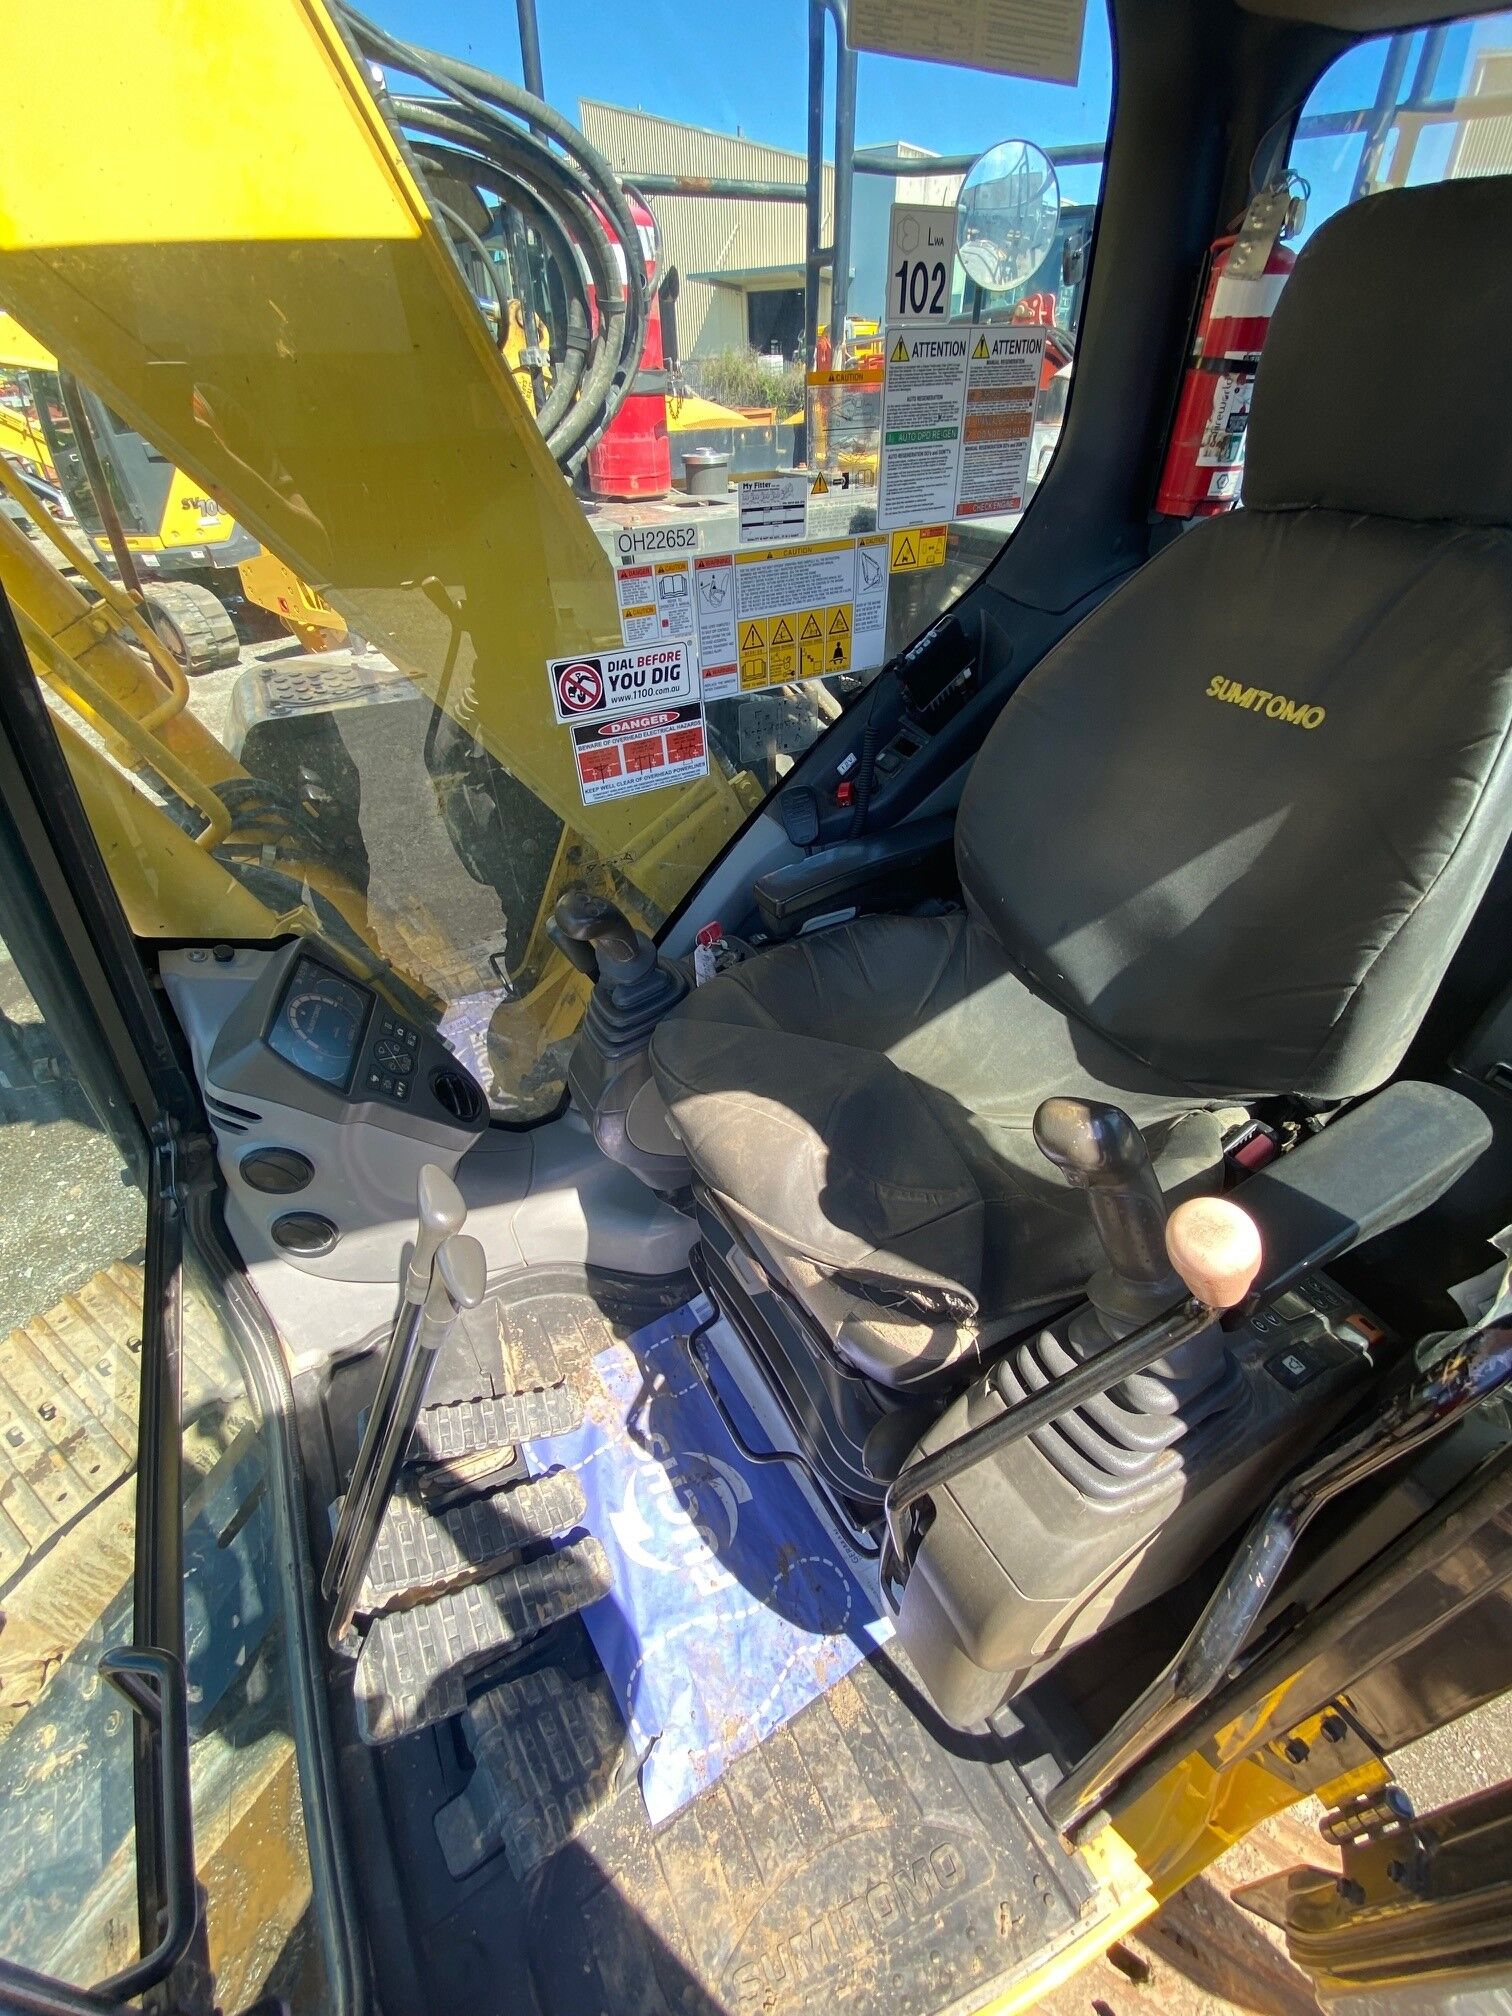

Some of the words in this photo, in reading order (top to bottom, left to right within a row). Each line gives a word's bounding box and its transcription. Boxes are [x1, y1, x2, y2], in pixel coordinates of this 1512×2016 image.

[895, 260, 946, 314] 102
[911, 341, 966, 358] ATTENTION
[992, 339, 1042, 355] ATTENTION
[836, 374, 864, 382] CAUTION
[742, 482, 752, 490] My
[972, 503, 992, 512] CHECK
[993, 500, 1015, 510] ENGINE
[618, 528, 696, 552] OH22652
[784, 548, 812, 556] CAUTION
[629, 568, 650, 576] DANGER
[665, 562, 686, 570] CAUTION
[633, 606, 654, 616] CAUTION
[608, 659, 634, 672] DIAL
[638, 650, 681, 667] BEFORE
[608, 670, 646, 692] YOU
[652, 664, 680, 684] DIG
[611, 686, 680, 704] www.1100.com.au
[1206, 676, 1326, 729] SUMITOMO
[612, 714, 668, 734] DANGER
[578, 742, 602, 752] BEWARE
[612, 734, 642, 744] OVERHEAD
[644, 726, 676, 738] ELECTRICAL
[677, 720, 702, 731] HAZARDS
[585, 786, 600, 794] KEEP
[601, 782, 616, 791] WELL
[616, 778, 635, 788] CLEAR
[644, 770, 673, 782] OVERHEAD
[674, 762, 706, 774] POWERLINES
[630, 1433, 738, 1596] FUCHS
[732, 1842, 964, 2001] SUMITOMO
